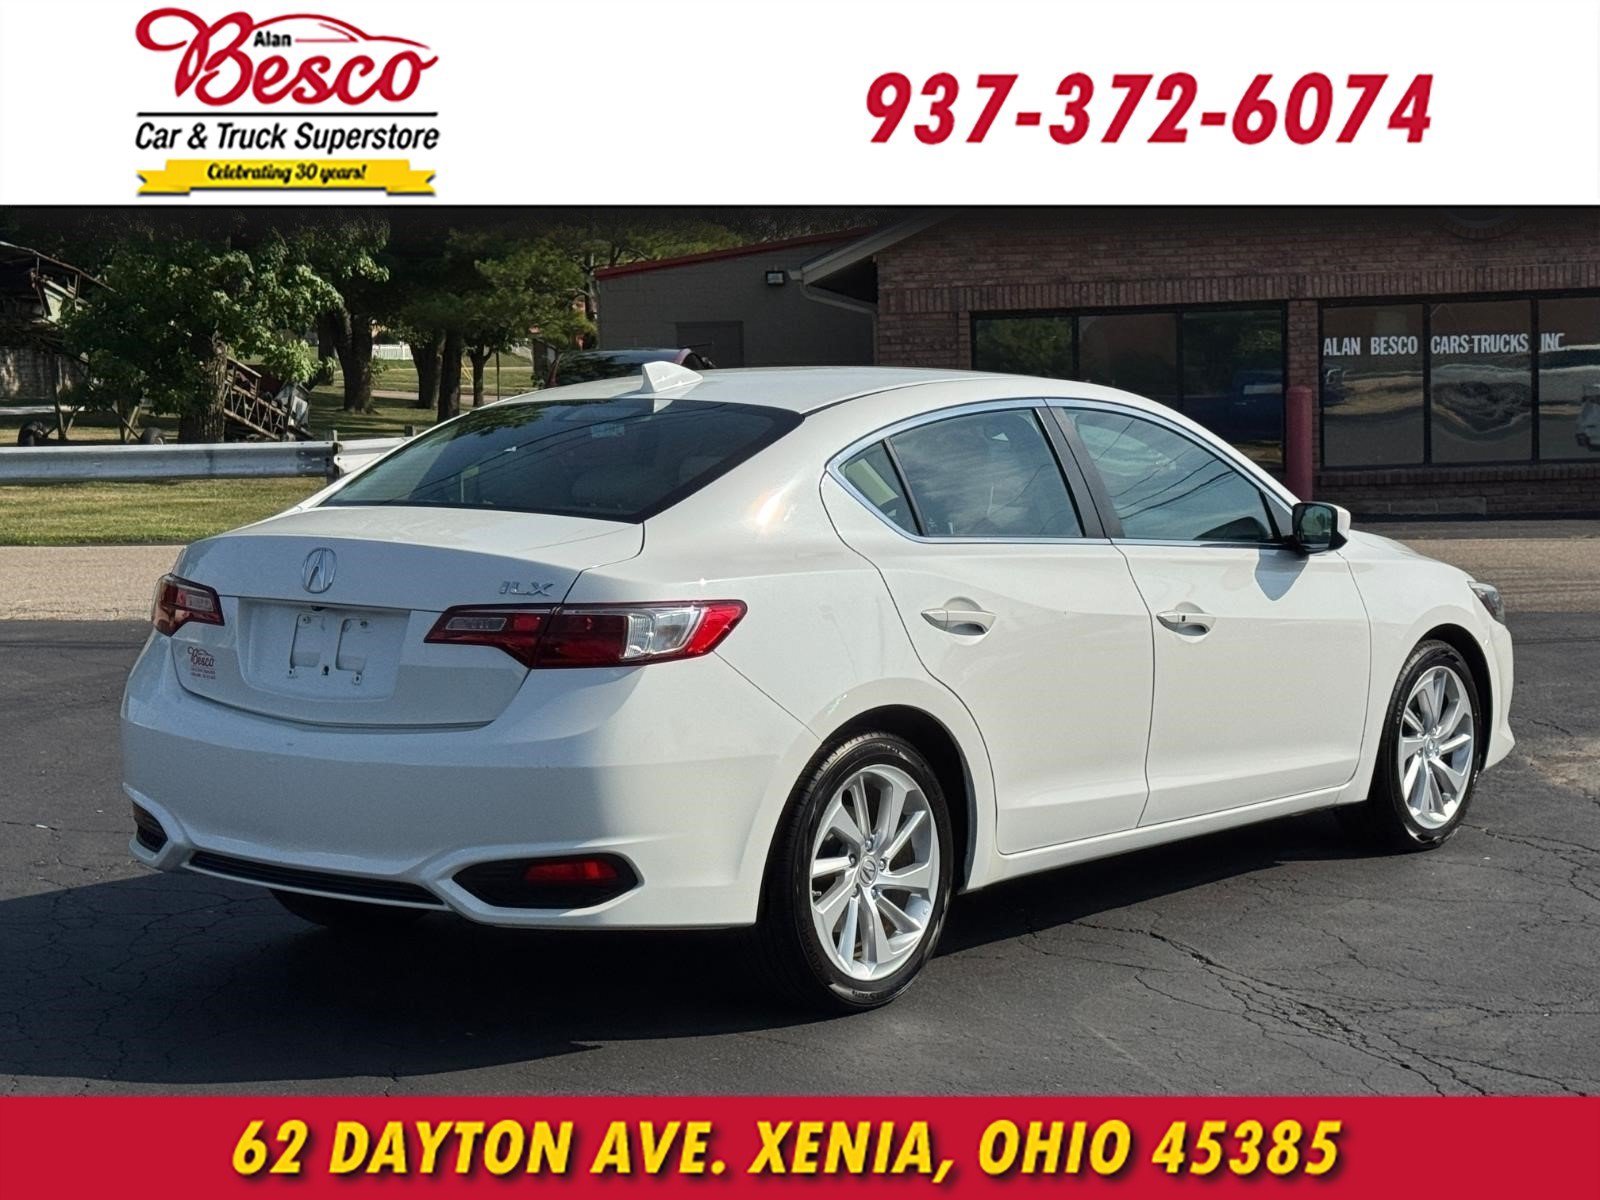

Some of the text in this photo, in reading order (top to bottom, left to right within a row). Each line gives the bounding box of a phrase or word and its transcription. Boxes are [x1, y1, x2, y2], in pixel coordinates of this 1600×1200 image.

[1322, 336, 1361, 356] ALAN
[1369, 335, 1418, 355] BESCO
[499, 580, 555, 597] ILX
